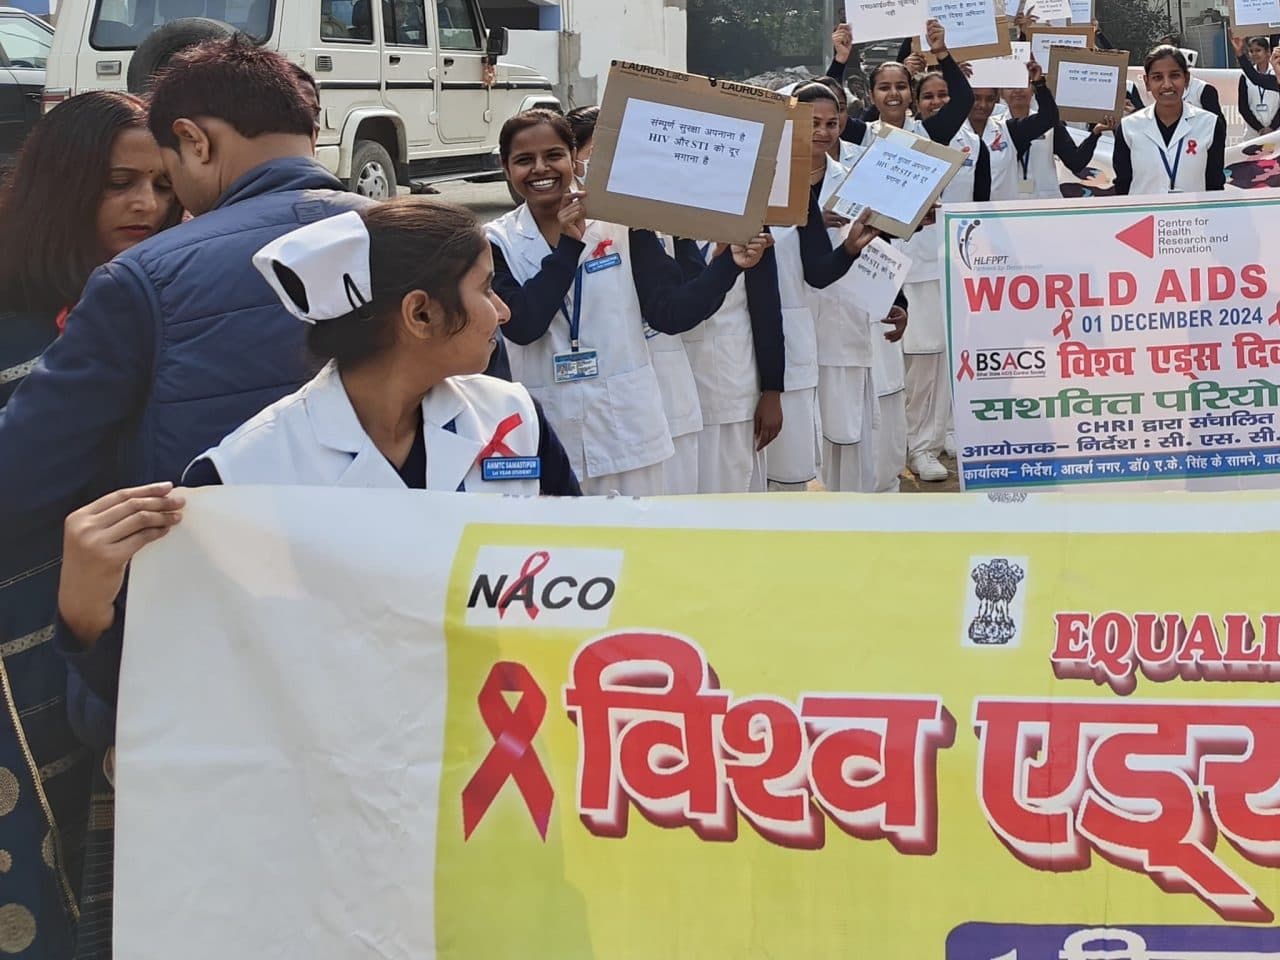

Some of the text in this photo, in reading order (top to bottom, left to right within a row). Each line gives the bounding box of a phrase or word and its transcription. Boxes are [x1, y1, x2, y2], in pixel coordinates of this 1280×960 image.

[621, 61, 665, 77] LAURUS
[721, 81, 764, 98] LAURUS
[650, 118, 747, 142] सम्पूर्ण सुरक्षा अपनाना है
[648, 132, 741, 159] HIV और STI को दूर
[702, 155, 710, 165] है
[1158, 217, 1209, 228] Centre for
[1158, 227, 1191, 236] Health
[1158, 234, 1229, 245] Research and
[1158, 244, 1212, 255] Innovation
[973, 255, 1009, 266] HLFPPT
[964, 271, 1137, 313] WORLD
[1154, 263, 1268, 304] AIDS
[1081, 306, 1264, 334] 01 DECEMBER 2024
[976, 350, 1046, 371] BSACS
[1056, 341, 1136, 379] विश्व
[1146, 341, 1222, 380] एड्स
[970, 387, 1145, 421] सशक्ति
[1077, 410, 1275, 434] CHRI द्वारा संचालित
[1077, 434, 1137, 452] निर्देश
[1158, 431, 1192, 448] सी.
[1200, 432, 1241, 446] एस.
[1060, 459, 1094, 475] आदर्श
[1097, 460, 1125, 475] नगर,
[1186, 453, 1208, 469] सिंह
[1210, 453, 1222, 468] के
[1226, 450, 1261, 467] सामने,
[467, 560, 616, 617] NACO
[563, 628, 952, 852] विश्व
